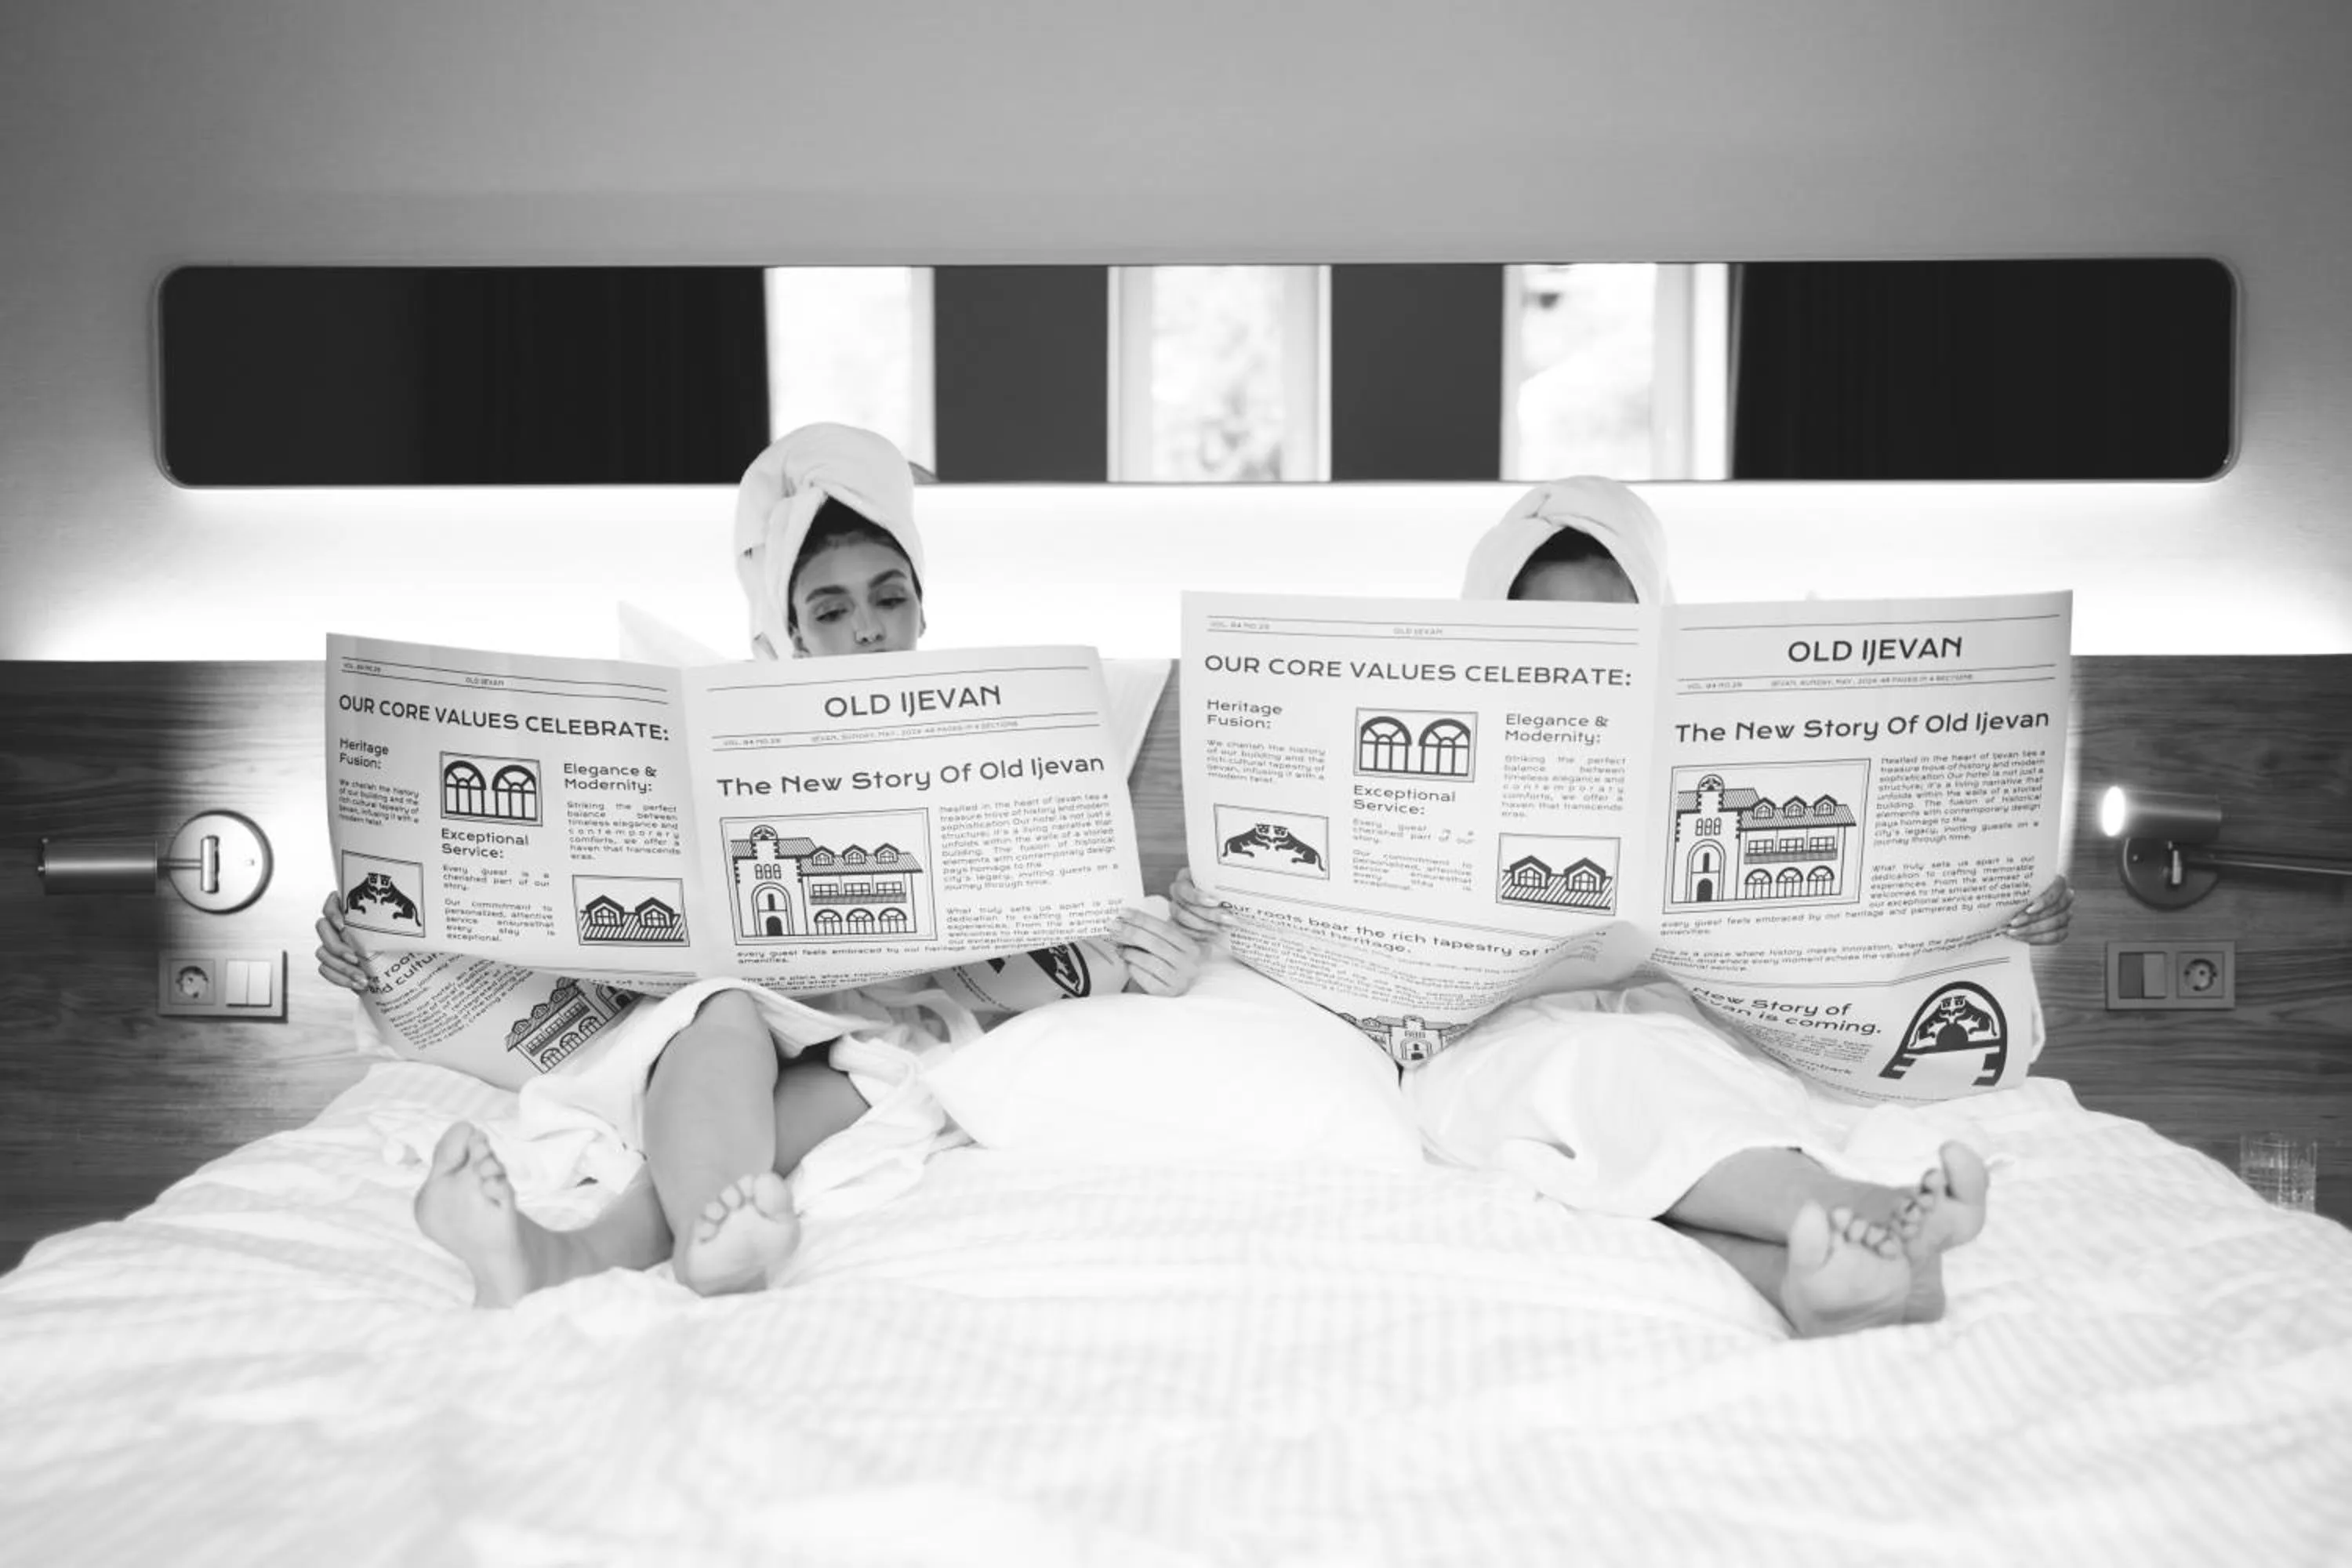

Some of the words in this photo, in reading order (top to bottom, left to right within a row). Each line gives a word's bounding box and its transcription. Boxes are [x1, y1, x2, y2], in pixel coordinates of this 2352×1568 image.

[1788, 641, 1853, 662] OLD
[1862, 637, 1962, 665] IJEVAN
[1204, 654, 1260, 673] OUR
[1268, 656, 1341, 677] CORE
[1350, 659, 1456, 681] VALUES
[1465, 663, 1632, 686] CELEBRATE:
[824, 692, 891, 717] OLD
[901, 684, 1001, 717] IJEVAN
[1207, 699, 1283, 717] Heritage
[338, 693, 376, 714] OUR
[379, 699, 430, 721] CORE
[434, 706, 520, 730] VALUES
[524, 714, 669, 742] CELEBRATE:
[1207, 713, 1271, 729] Fusion:
[1505, 713, 1590, 729] Elegance
[1595, 716, 1608, 728] &
[1675, 721, 1726, 742] The
[1735, 720, 1795, 740] New
[1804, 717, 1879, 740] Story
[1887, 713, 1919, 735] Of
[1925, 711, 1969, 733] Old
[1975, 710, 2049, 735] Ijevan
[1504, 729, 1601, 746] Modernity:
[339, 739, 389, 757] Heritage
[339, 753, 382, 770] Fusion:
[564, 763, 641, 778] Elegance
[644, 765, 657, 777] &
[717, 775, 771, 797] The
[781, 771, 842, 793] New
[852, 768, 931, 790] Story
[940, 760, 971, 783] Of
[979, 757, 1023, 780] Old
[1030, 754, 1105, 782] Ijevan
[564, 778, 652, 795] Modernity:
[1353, 785, 1456, 802] Exceptional
[1353, 799, 1425, 815] Service:
[441, 828, 529, 846] Exceptional
[441, 843, 503, 858] Service:
[1218, 901, 1250, 913] Our
[1257, 909, 1302, 923] roots
[1309, 917, 1348, 931] bear
[1356, 926, 1385, 938] the
[1392, 933, 1426, 944] rich
[1433, 935, 1512, 956] tapestry
[1330, 930, 1411, 952] heritage.
[1751, 999, 1818, 1018] Story
[1825, 1003, 1853, 1016] of
[1759, 1011, 1778, 1021] is
[1784, 1017, 1882, 1036] coming.
